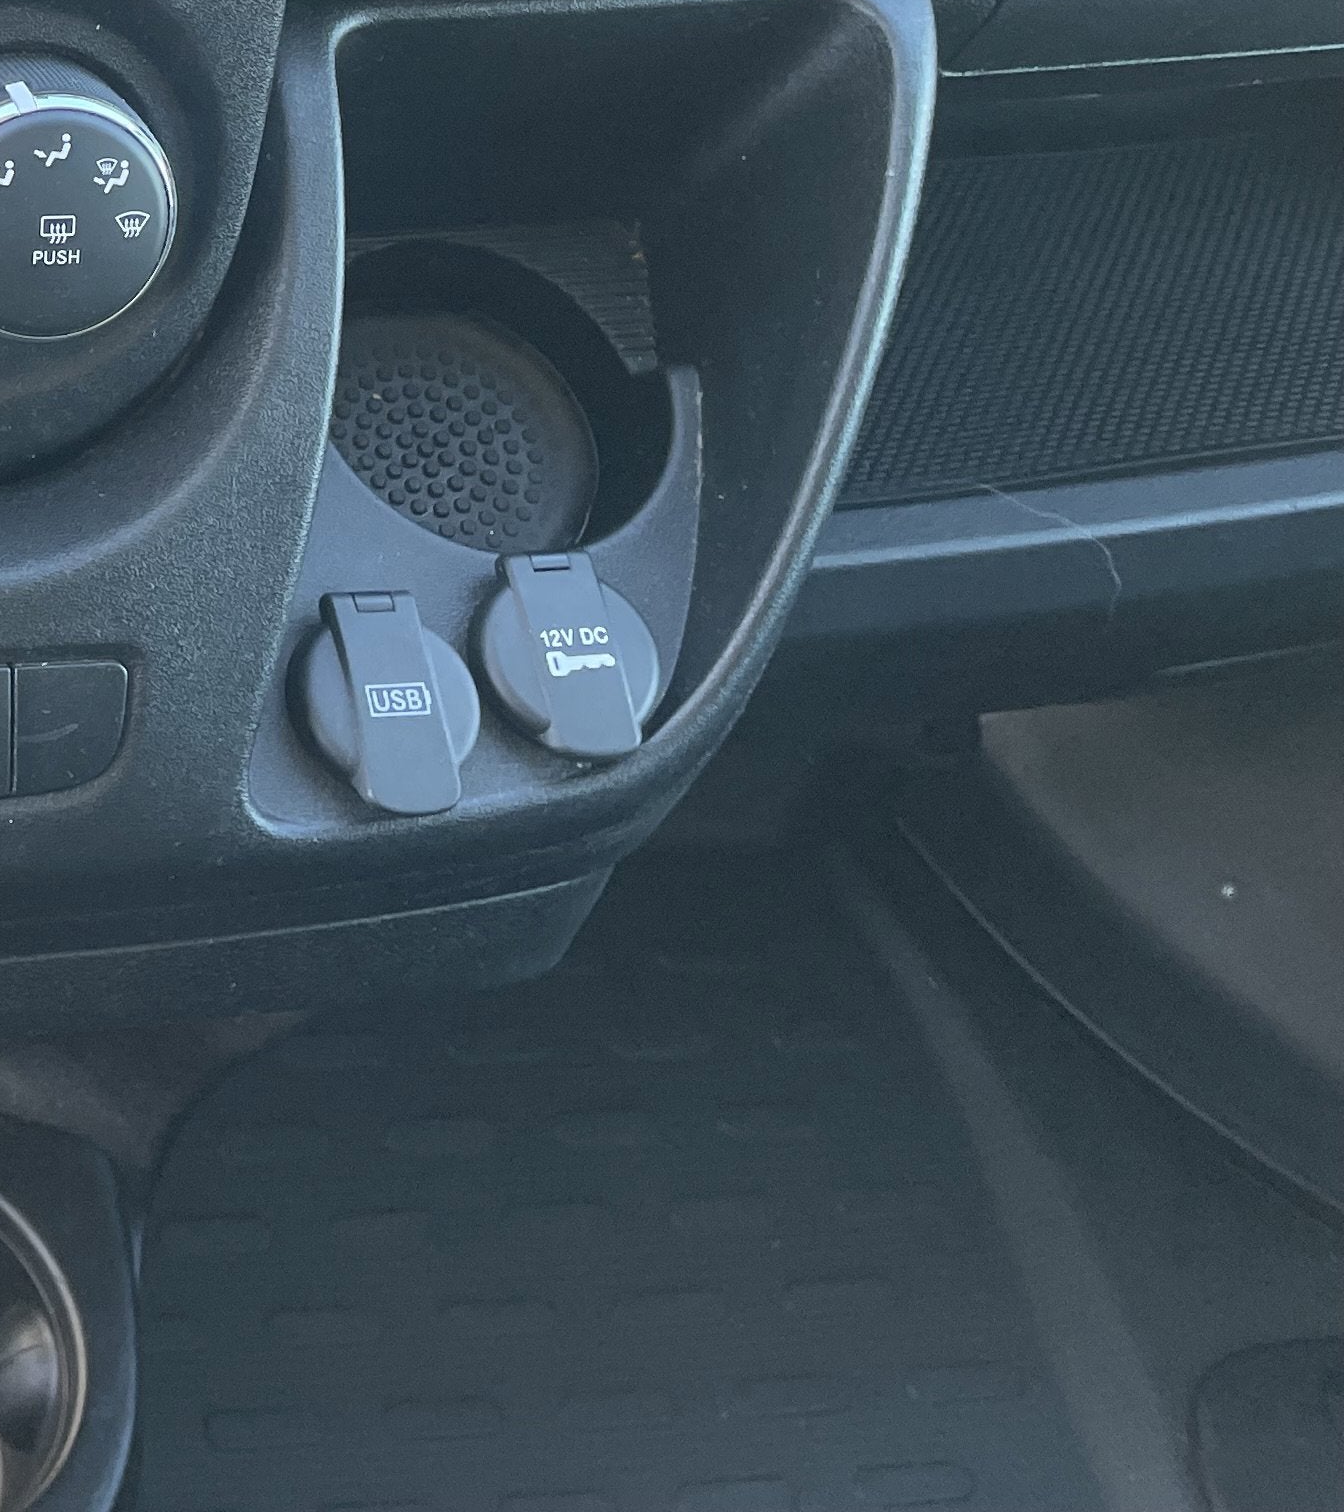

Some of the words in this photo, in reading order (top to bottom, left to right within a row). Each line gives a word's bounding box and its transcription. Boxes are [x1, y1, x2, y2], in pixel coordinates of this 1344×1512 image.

[32, 249, 80, 265] PUSH
[539, 628, 573, 648] 12V
[578, 626, 609, 645] DC
[371, 688, 423, 713] USB
